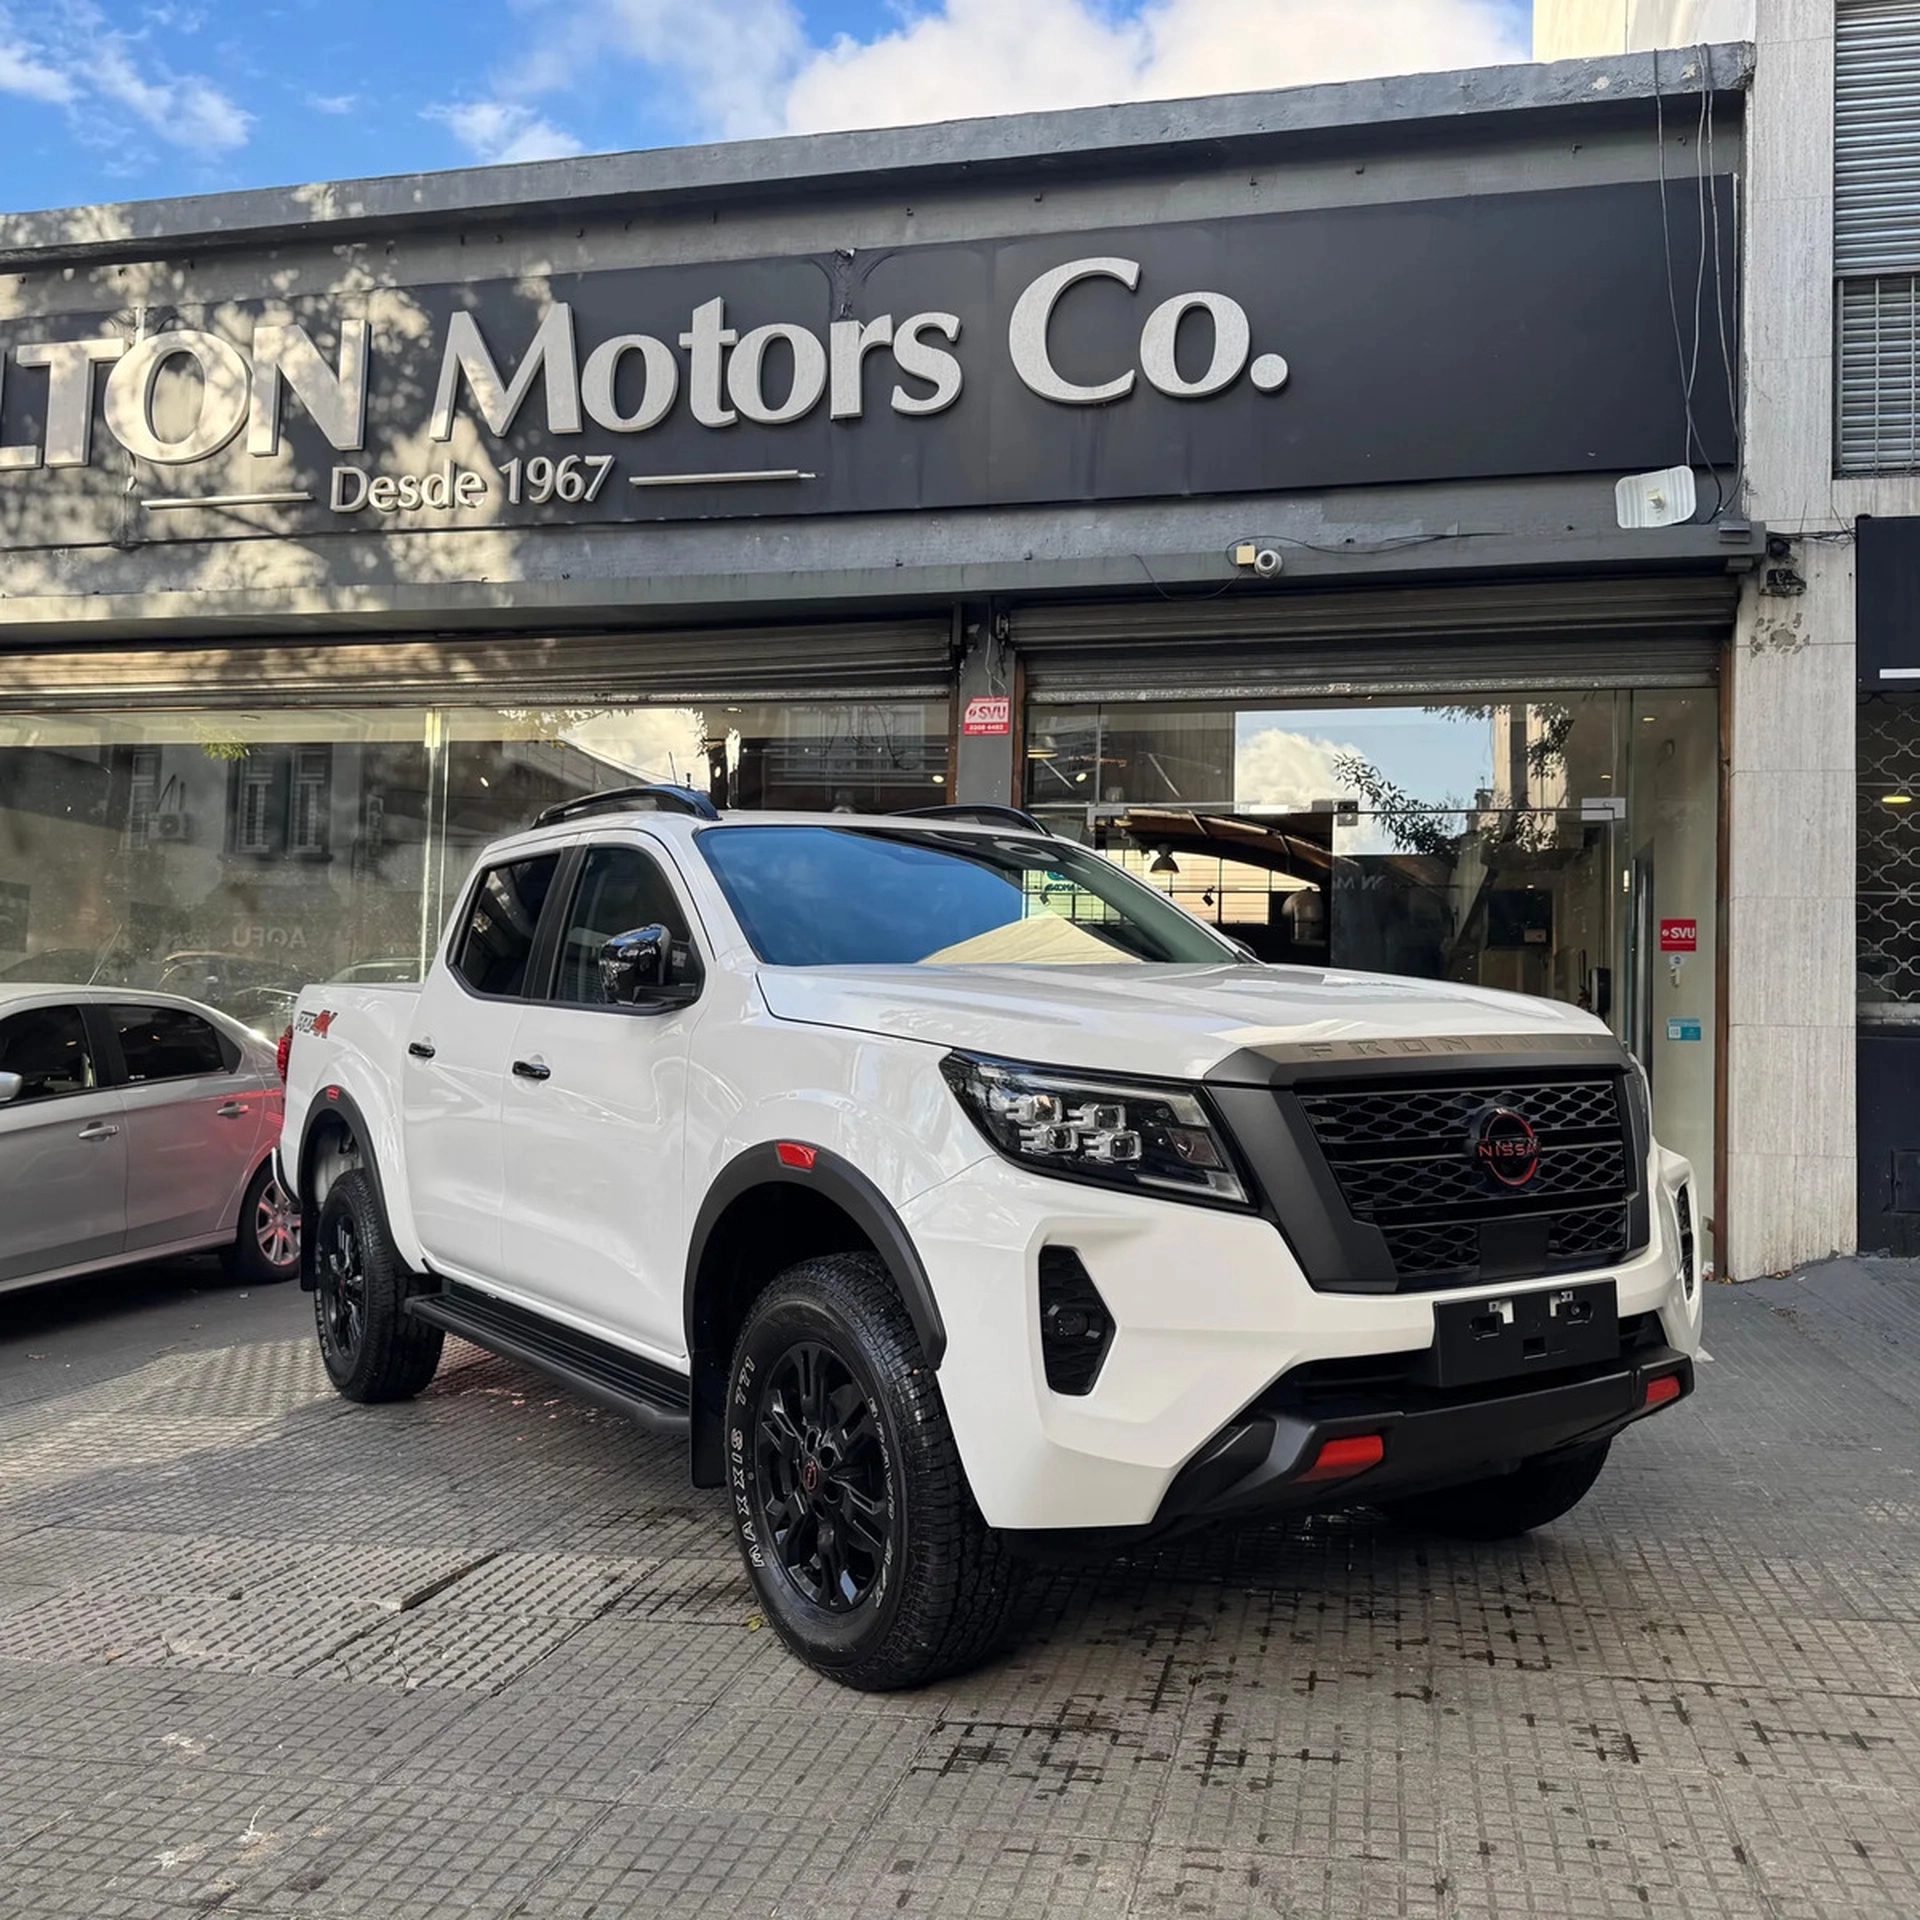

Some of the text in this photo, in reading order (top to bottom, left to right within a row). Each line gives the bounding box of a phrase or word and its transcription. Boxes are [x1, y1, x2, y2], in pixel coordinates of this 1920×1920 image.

[429, 297, 963, 441] Motors
[1009, 257, 1288, 404] Co.
[330, 454, 615, 514] Desde 1967
[979, 705, 1007, 719] SVU
[1670, 927, 1696, 939] SVU
[1478, 1142, 1540, 1157] NISSA
[730, 1427, 765, 1568] MAXXIS
